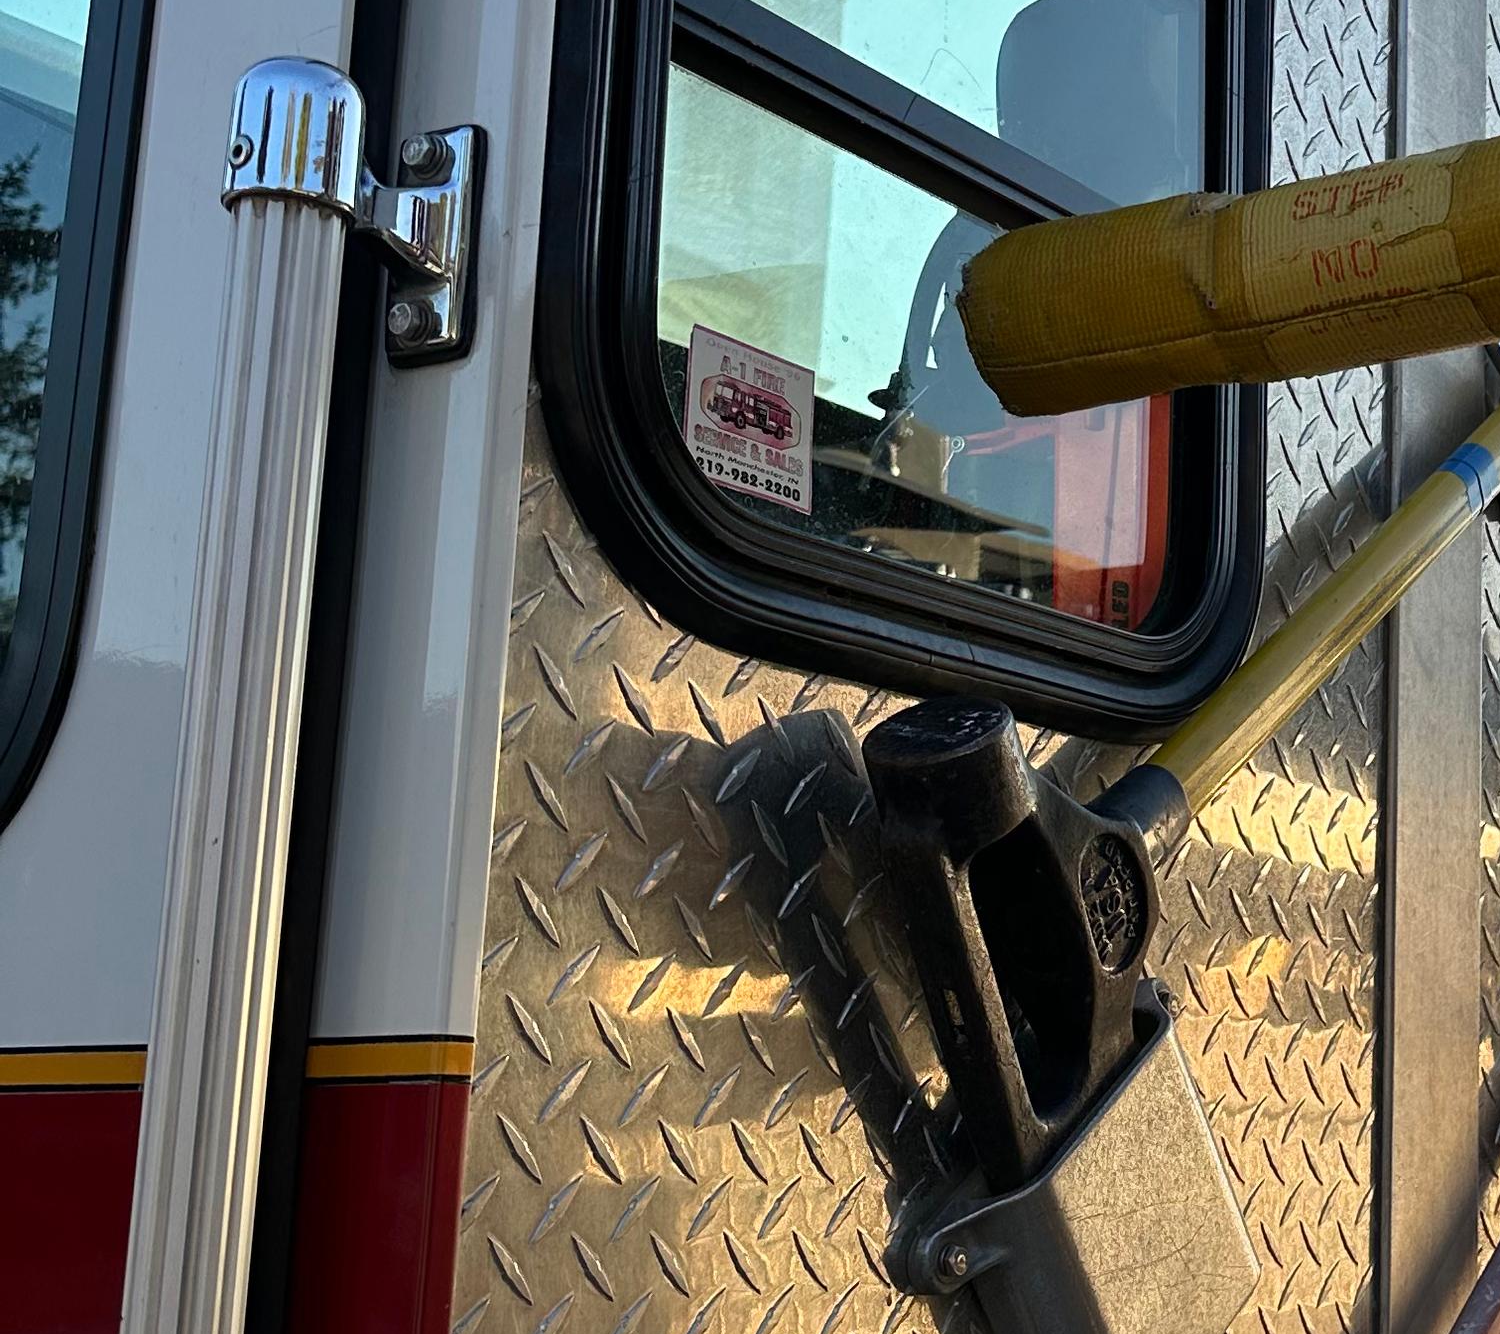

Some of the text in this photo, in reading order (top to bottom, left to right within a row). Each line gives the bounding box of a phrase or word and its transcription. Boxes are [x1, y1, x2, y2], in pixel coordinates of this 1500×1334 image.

[1311, 238, 1380, 288] NO
[720, 354, 786, 395] A-1 FIRE
[694, 423, 803, 477] SERVICE & SALES
[696, 445, 799, 485] North Manchester, IN
[696, 456, 801, 502] 219-982-2200
